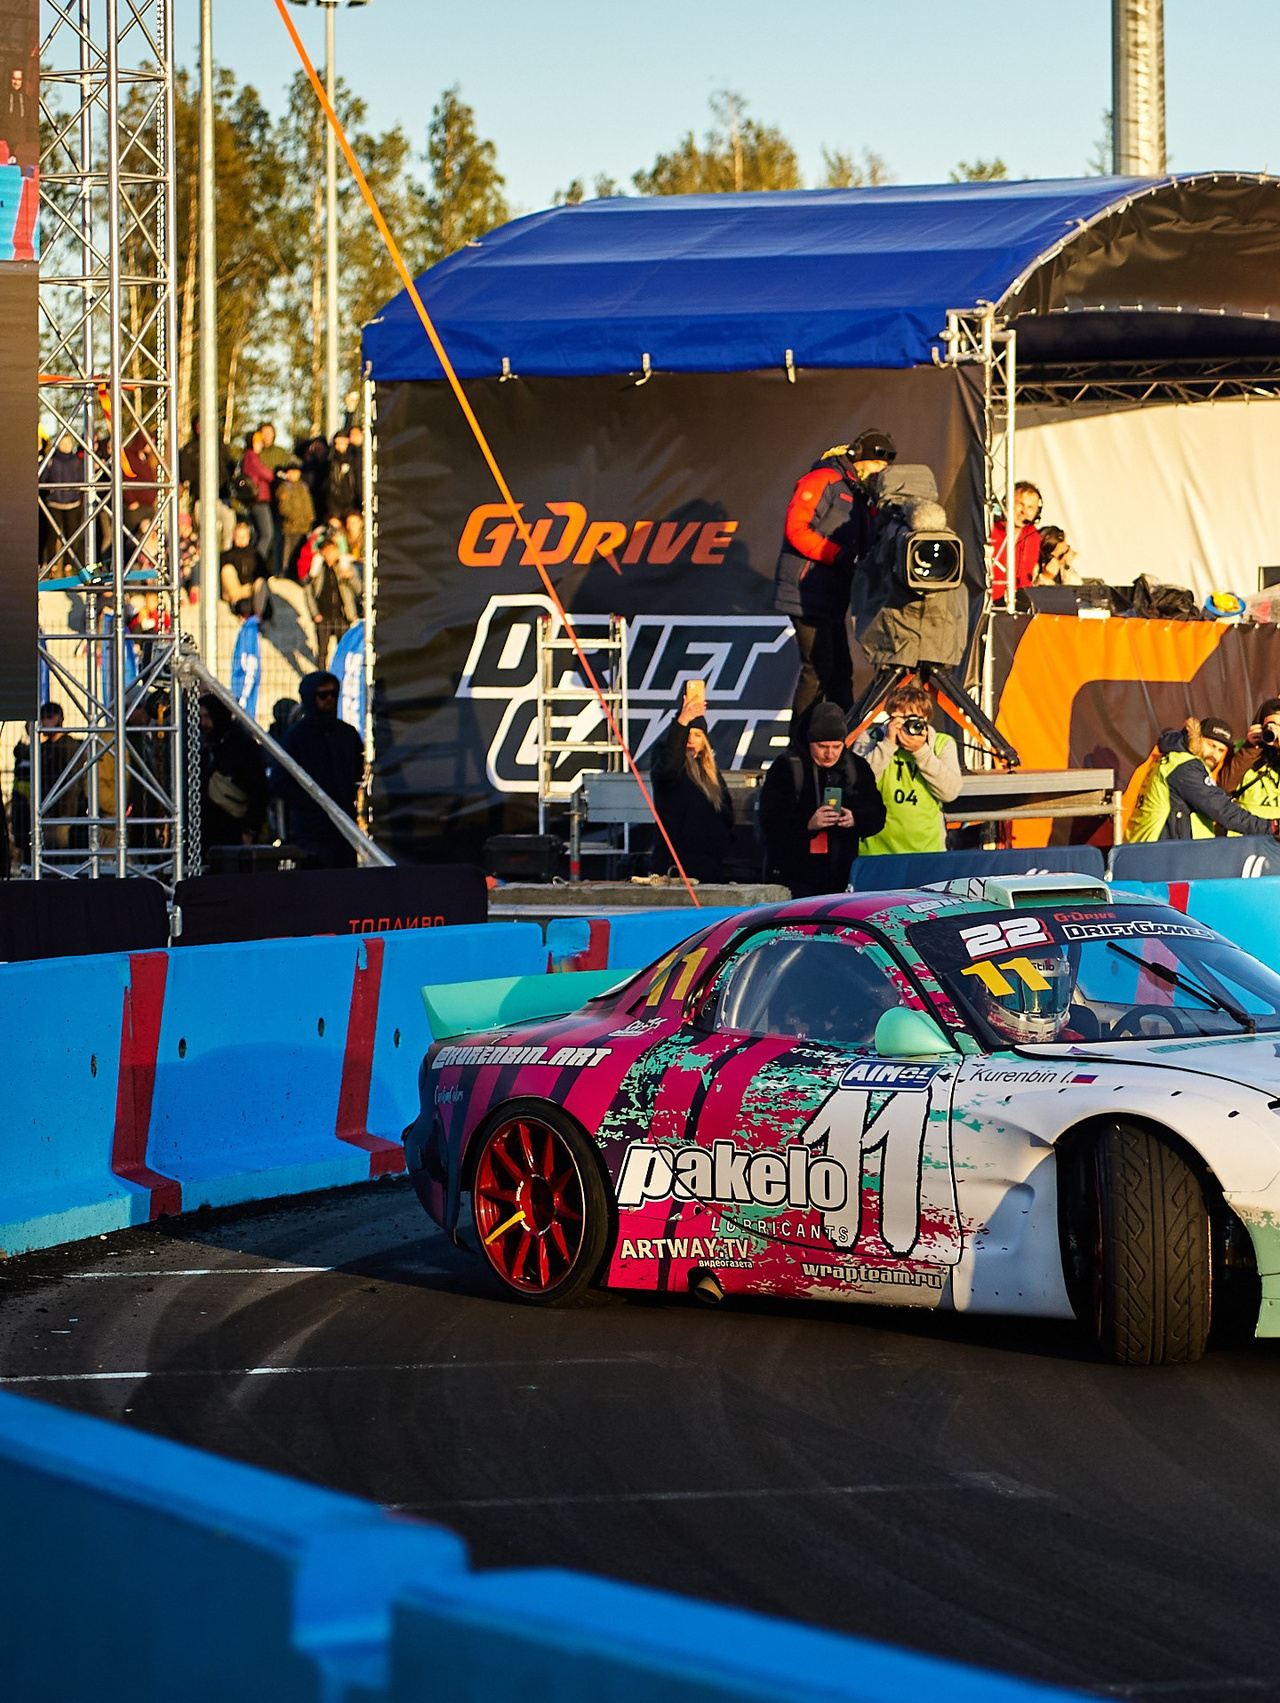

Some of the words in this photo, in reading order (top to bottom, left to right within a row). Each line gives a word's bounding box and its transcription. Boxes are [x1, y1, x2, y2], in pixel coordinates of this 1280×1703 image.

[894, 788, 918, 806] 04
[1259, 795, 1279, 808] 41
[959, 917, 1054, 960] 22
[645, 947, 709, 1007] 11
[960, 956, 1052, 997] 11
[846, 1063, 934, 1084] AIMOL
[970, 1068, 1055, 1084] Kurenbin
[617, 1139, 849, 1213] pakelo
[800, 1086, 932, 1258] 11
[711, 1215, 850, 1243] LUBRICANTS
[620, 1237, 749, 1261] ARTWAY.TV
[698, 1259, 753, 1269] видеогазета
[801, 1262, 943, 1290] wrapteam.ru
